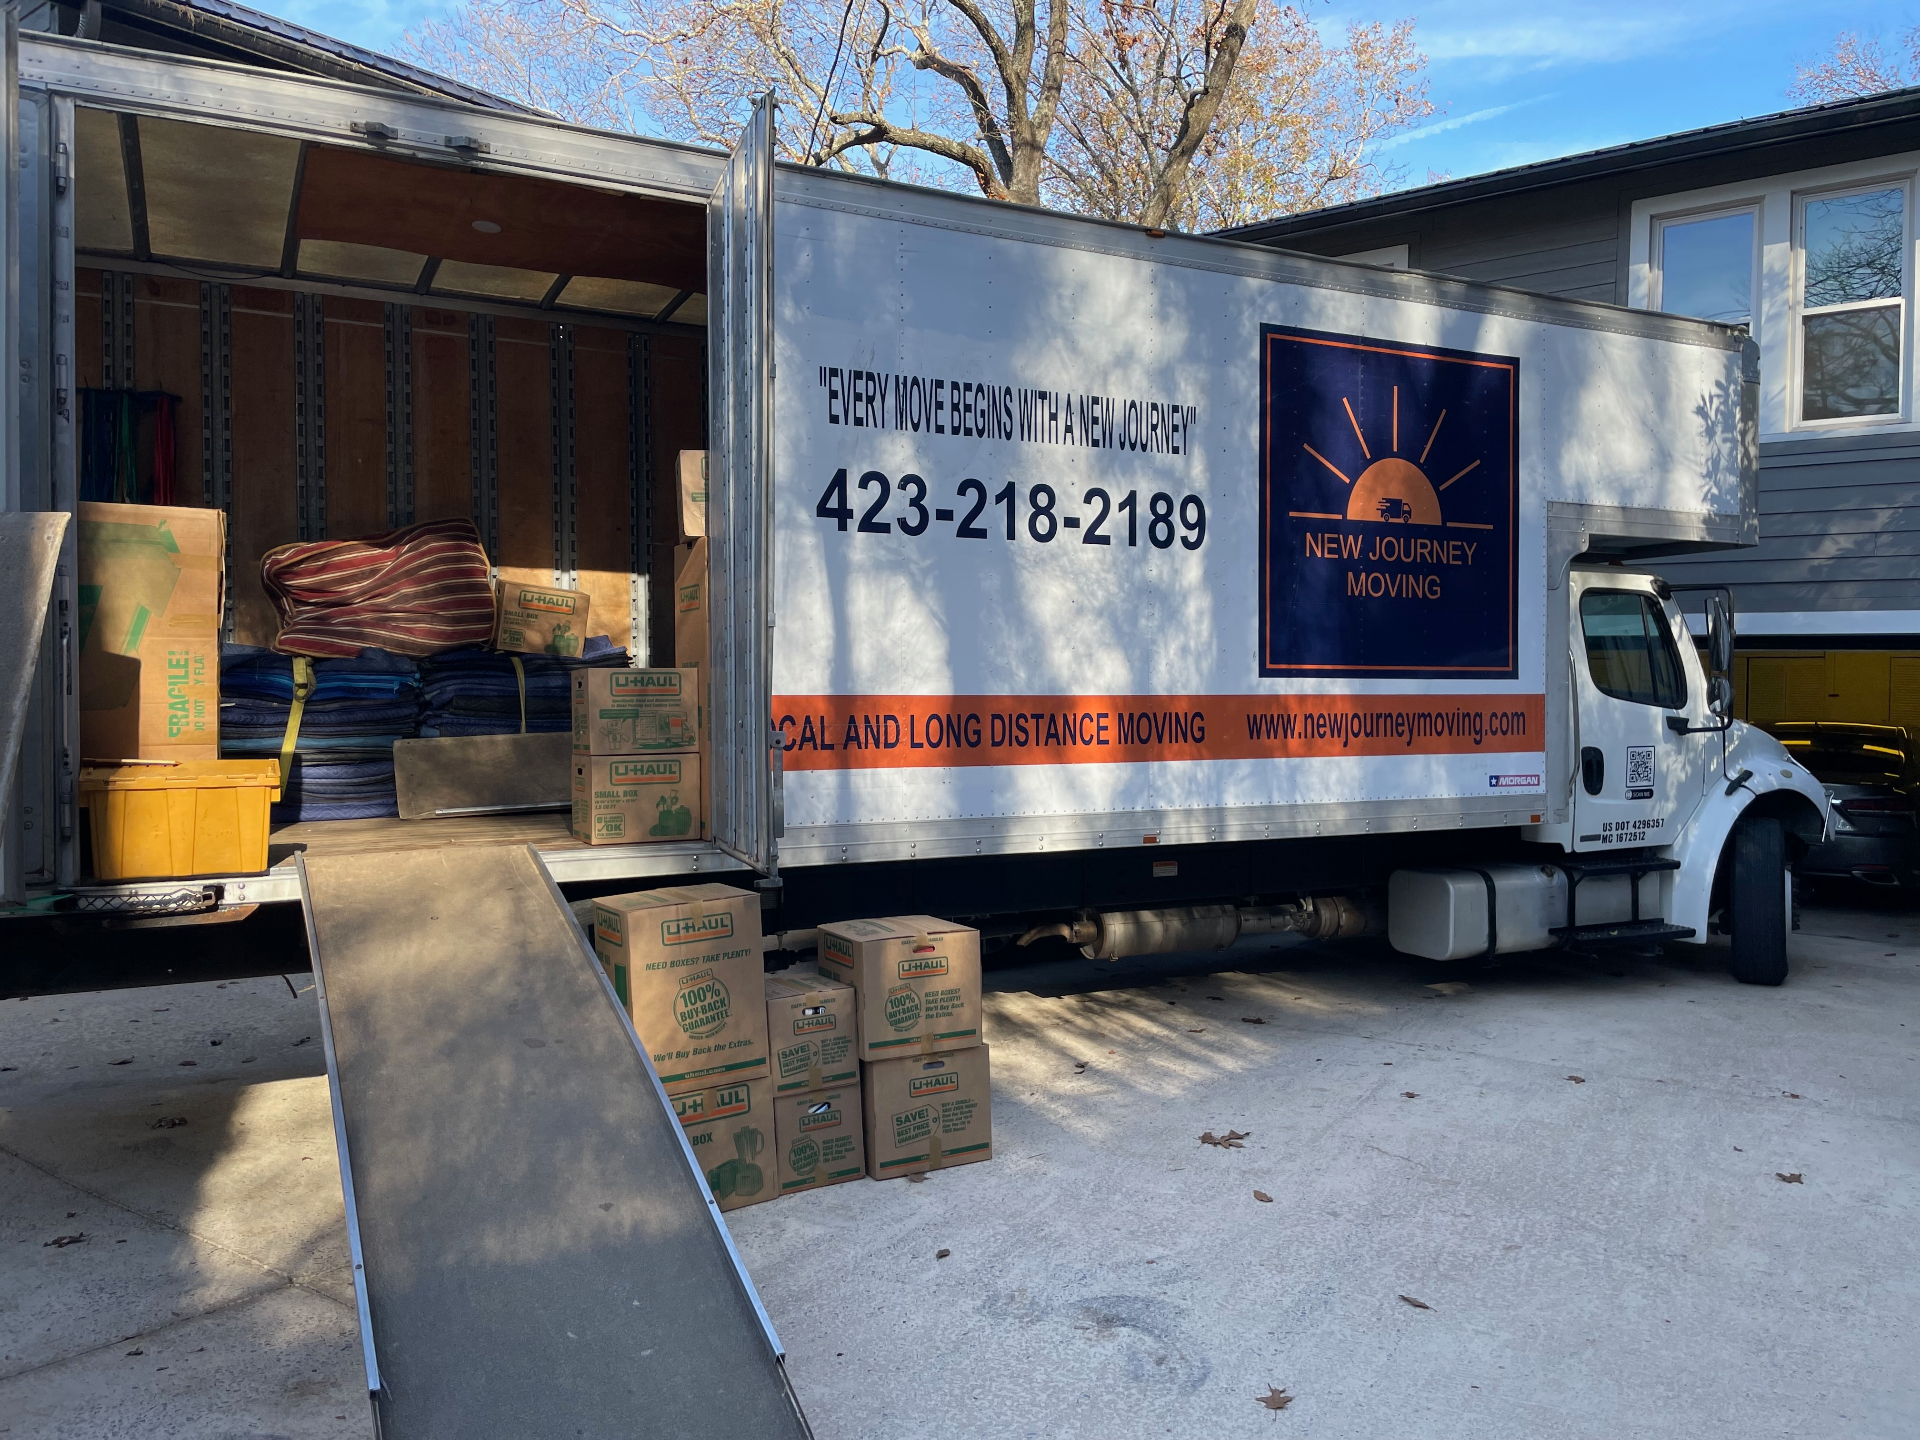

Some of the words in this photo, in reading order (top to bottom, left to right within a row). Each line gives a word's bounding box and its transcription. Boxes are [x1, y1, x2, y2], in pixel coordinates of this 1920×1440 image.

[819, 366, 889, 430] "EVERY
[894, 374, 945, 435] MOVE
[950, 380, 1013, 441] BEGINS
[1018, 388, 1060, 445] WITH
[1063, 393, 1075, 446] A
[1079, 394, 1115, 449] NEW
[1118, 399, 1197, 455] JOURNEY"
[816, 468, 1207, 551] 423-218-2189
[1305, 532, 1362, 560] NEW
[1369, 536, 1477, 565] JOURNEY
[1347, 572, 1441, 599] MOVING
[523, 594, 572, 607] U-HAUL
[503, 610, 524, 618] SMALL
[615, 676, 677, 687] U-HAUL
[770, 714, 835, 751] CAL
[843, 714, 901, 750] AND
[910, 713, 981, 749] LONG
[990, 713, 1109, 748] DISTANCE
[1117, 712, 1206, 746] MOVING
[1246, 707, 1526, 748] www.newjourneymoving.com
[615, 764, 676, 775] U-HAUL
[1499, 776, 1538, 786] MORGAN
[623, 789, 638, 797] BOX
[605, 823, 623, 832] OK
[1602, 822, 1613, 832] US
[1615, 821, 1630, 831] DOT
[1632, 819, 1665, 829] 4296357
[1602, 833, 1613, 844] MC
[1616, 831, 1646, 843] 1672512
[666, 916, 729, 935] U-HAUL
[826, 937, 852, 957] U-HAUL
[645, 962, 667, 971] NEED
[669, 958, 699, 968] BOXES?
[702, 954, 720, 963] TAKE
[722, 949, 751, 960] PLENTY!
[902, 960, 945, 972] U-HAUL
[681, 972, 711, 985] U-HAUL
[680, 982, 720, 1008] 100%
[889, 993, 915, 1010] 100%
[680, 997, 727, 1022] BUY-BACK
[889, 1003, 919, 1019] BUY-BACK
[682, 1009, 731, 1033] GUARANTEE
[796, 1017, 834, 1029] U-HAUL
[654, 1052, 673, 1062] We'll
[675, 1050, 690, 1060] Buy
[692, 1046, 712, 1056] Back
[714, 1043, 726, 1052] the
[728, 1039, 754, 1049] Extras.
[781, 1043, 810, 1059] SAVE!
[685, 1067, 726, 1079] uhaul.com
[913, 1076, 955, 1090] U-HAUL
[672, 1090, 745, 1116] U-HUL
[802, 1113, 839, 1126] U-HAUL
[896, 1108, 929, 1126] SAVE!
[897, 1127, 911, 1137] BEST
[913, 1122, 930, 1132] PRICE
[692, 1132, 713, 1146] BOX
